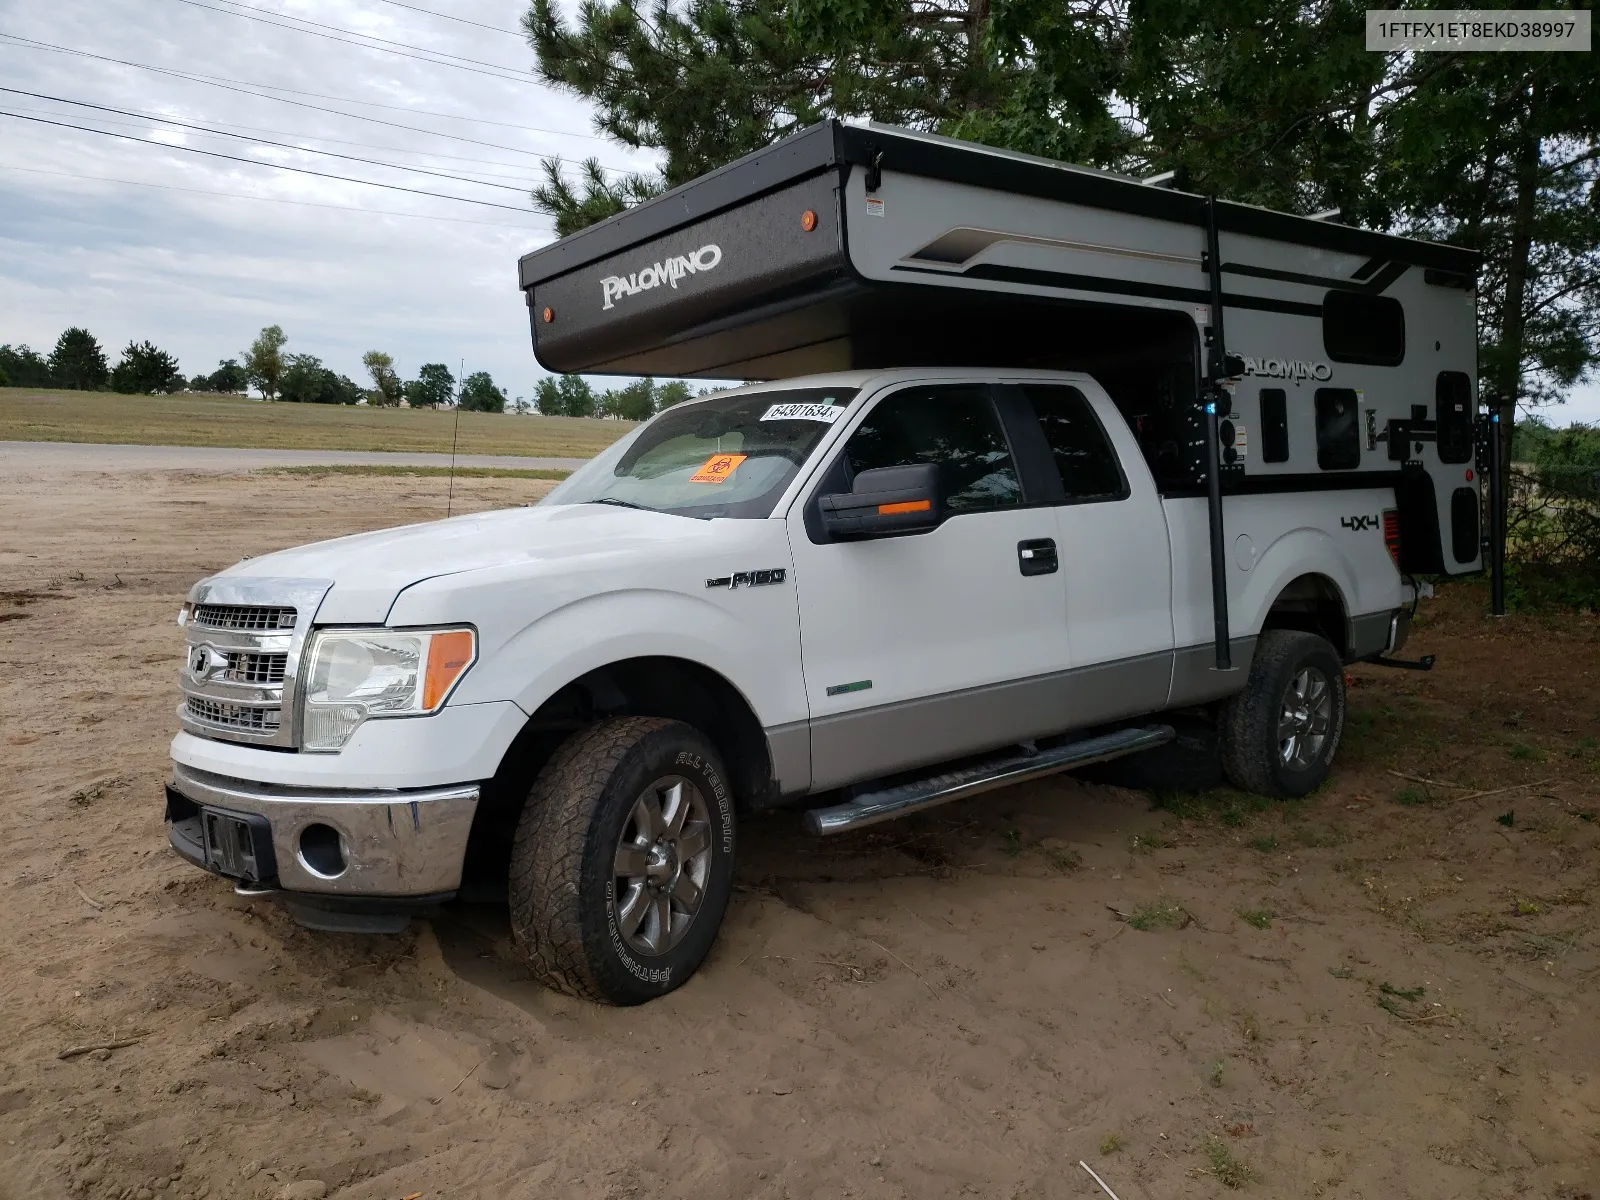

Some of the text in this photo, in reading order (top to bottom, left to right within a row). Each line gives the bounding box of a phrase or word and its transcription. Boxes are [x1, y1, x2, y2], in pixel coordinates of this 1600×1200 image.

[600, 244, 722, 310] PALOMINO
[676, 751, 732, 853] ALL TERRAIN
